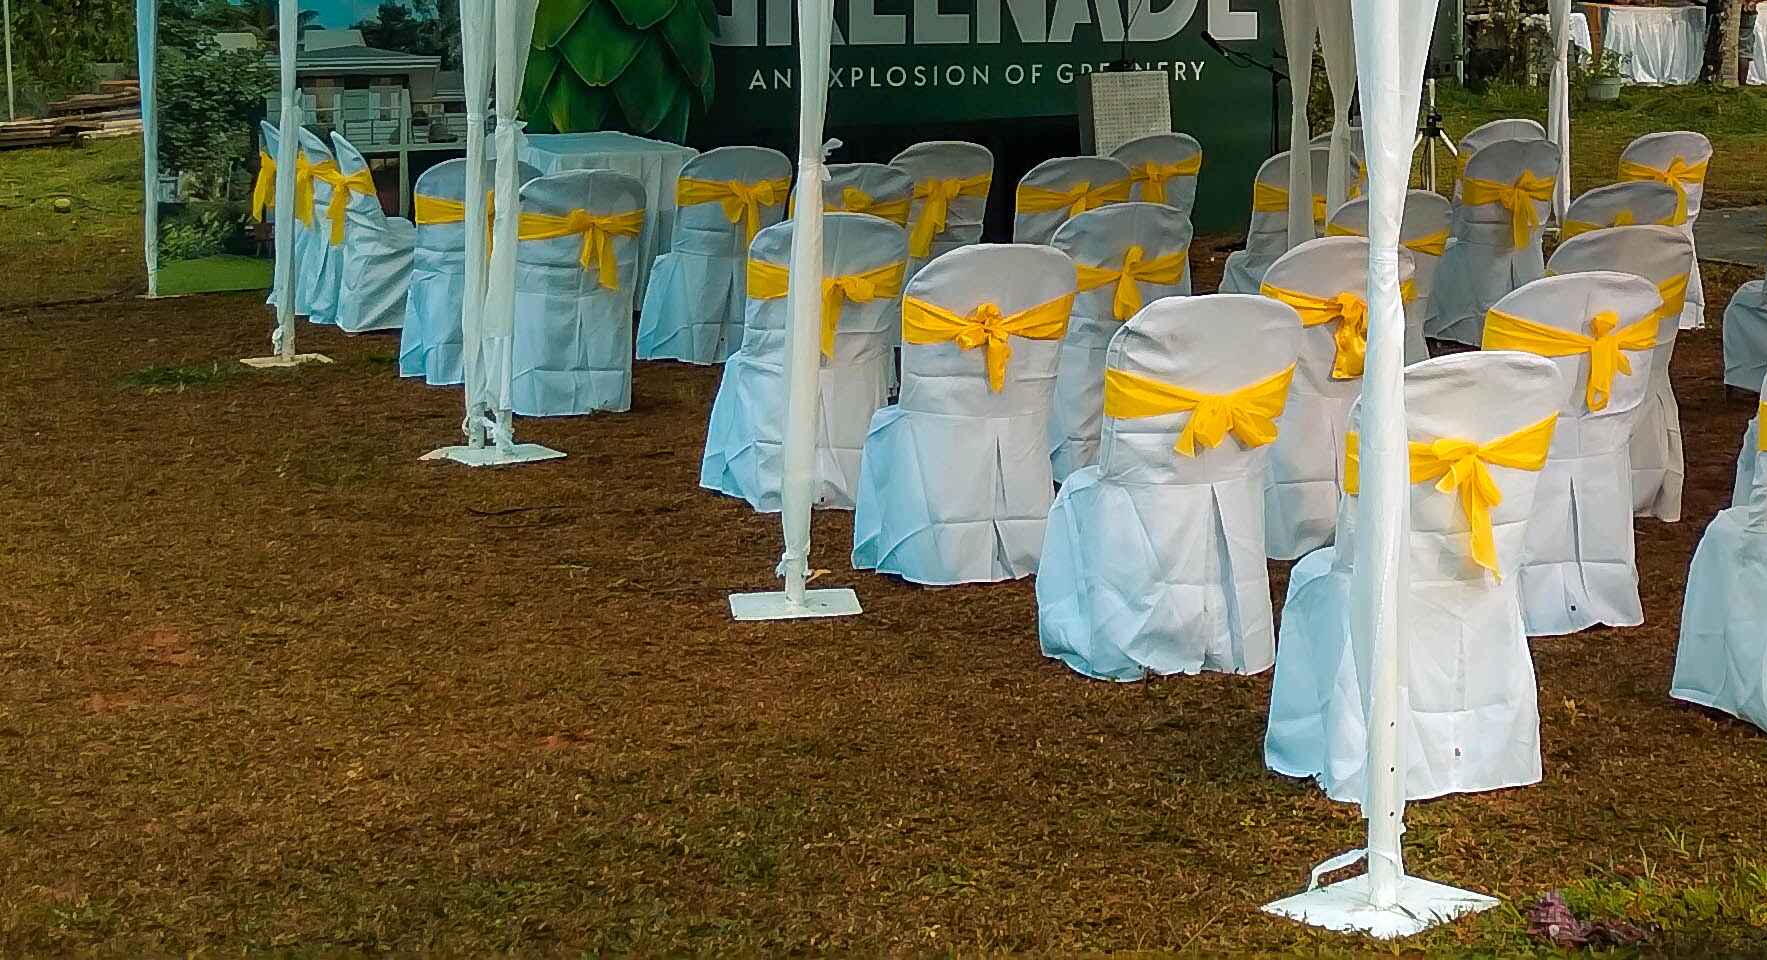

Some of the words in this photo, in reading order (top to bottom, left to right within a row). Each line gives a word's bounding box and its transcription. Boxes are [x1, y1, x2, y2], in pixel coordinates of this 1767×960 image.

[749, 68, 792, 90] AN
[828, 64, 989, 88] XPLOSION
[1004, 63, 1043, 85] OF
